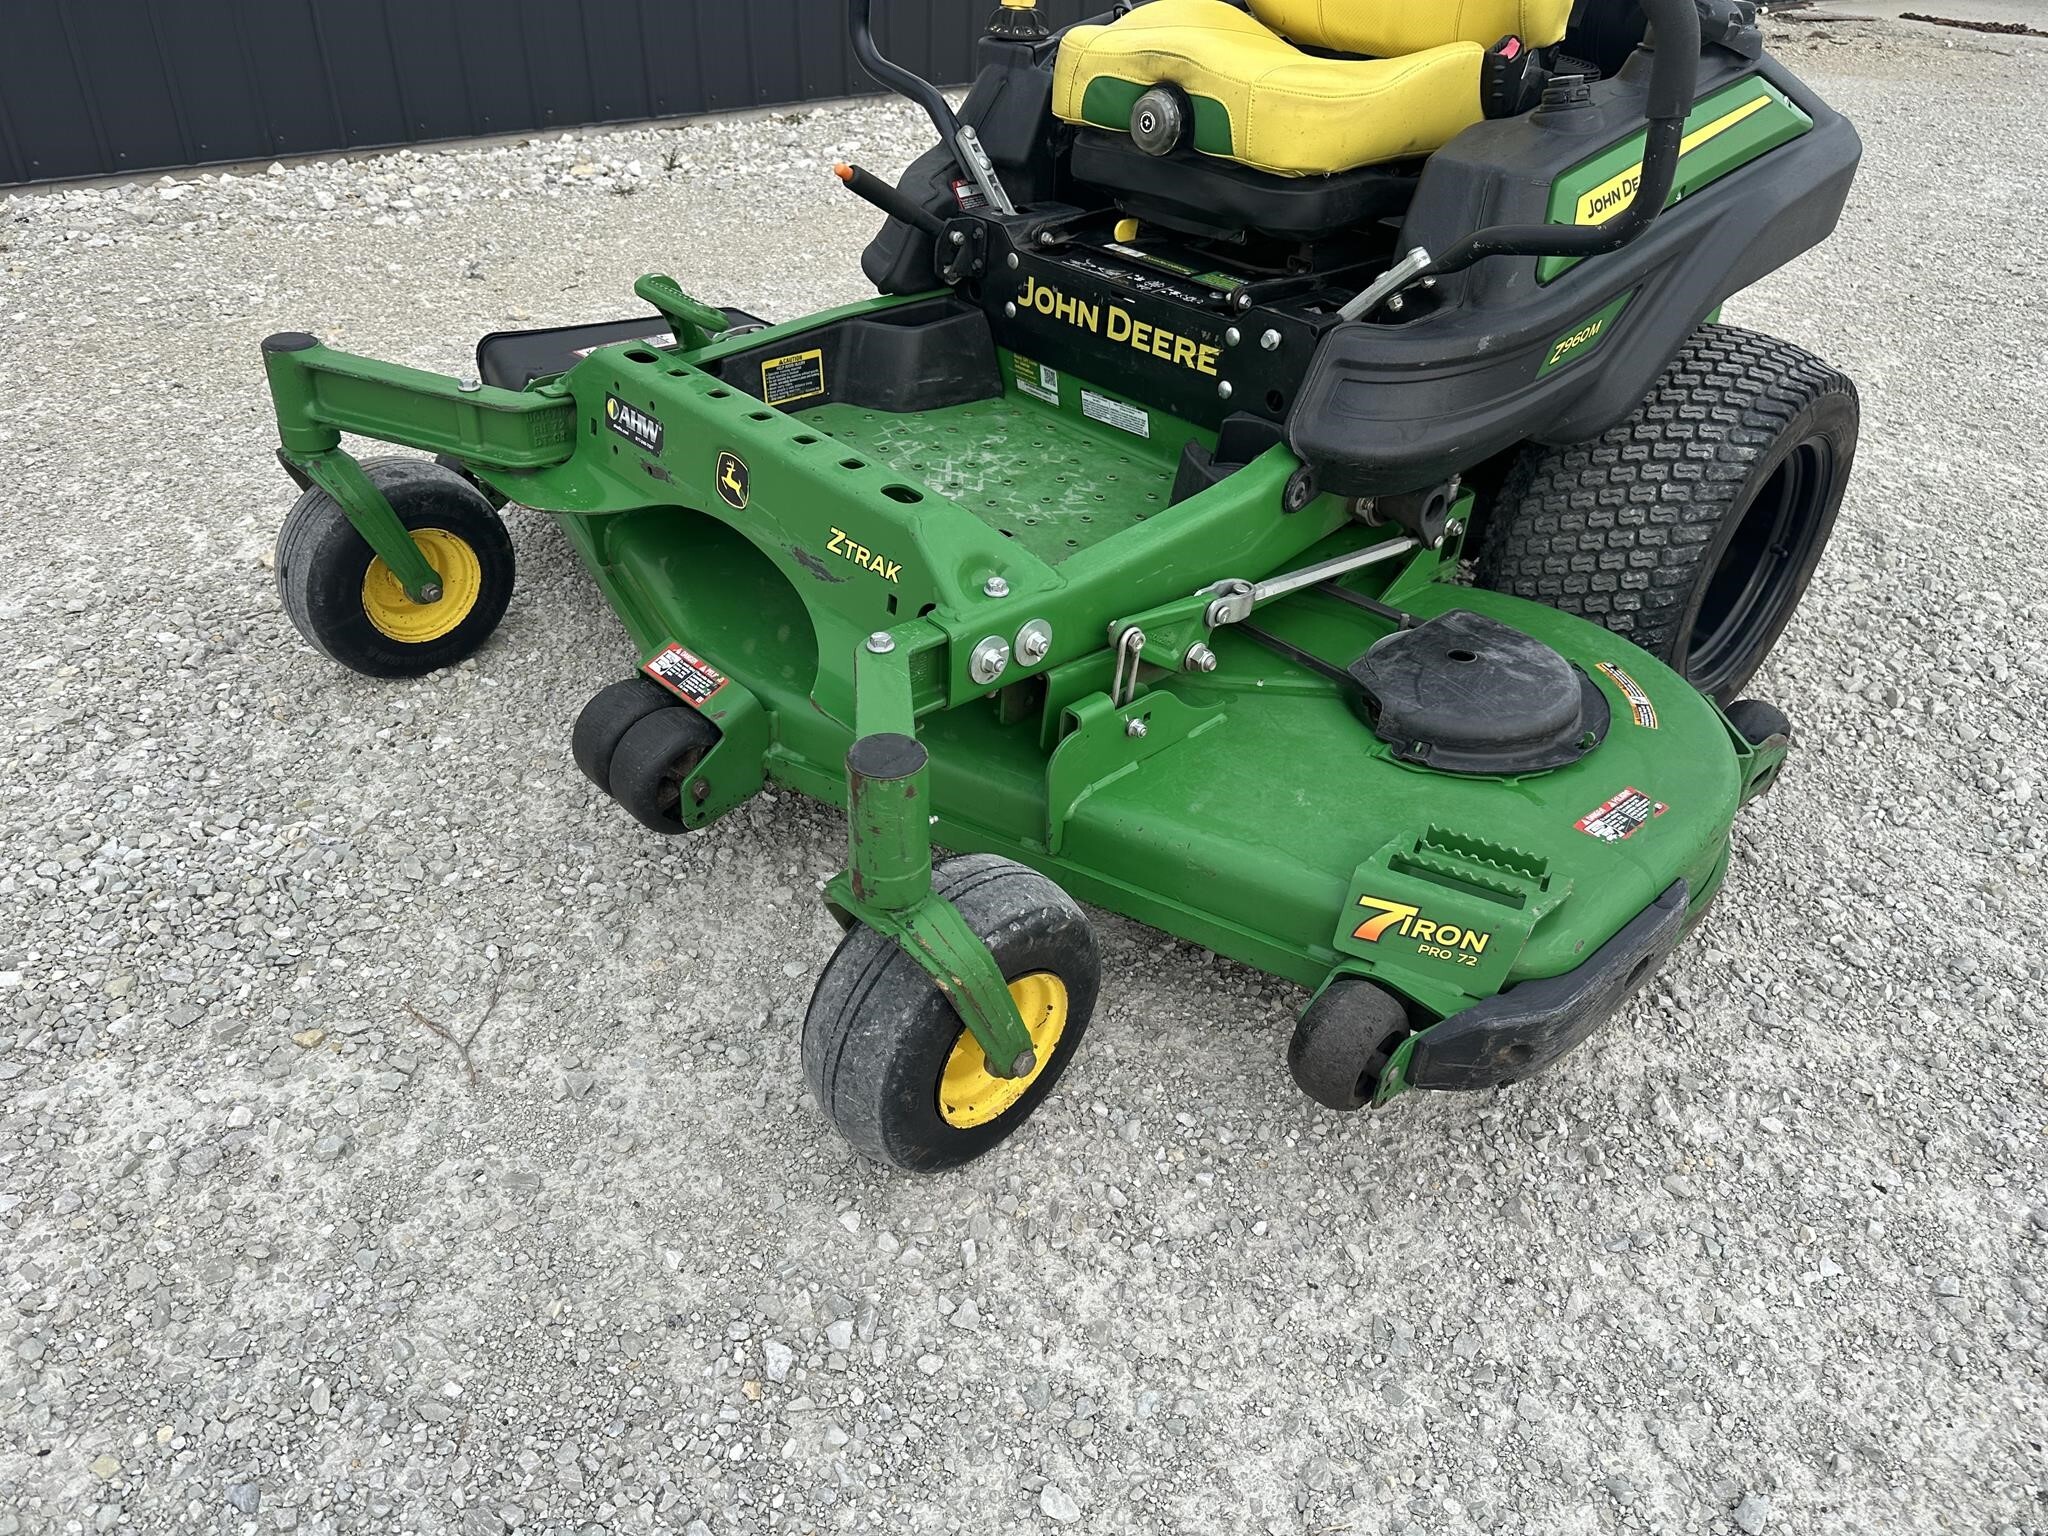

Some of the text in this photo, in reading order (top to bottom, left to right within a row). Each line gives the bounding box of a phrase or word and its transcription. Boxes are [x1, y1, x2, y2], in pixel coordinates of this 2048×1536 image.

[1588, 187, 1621, 219] JOHN
[1017, 275, 1099, 333] JOHN
[1106, 304, 1221, 377] DEERE
[1549, 319, 1603, 365] Z960M
[618, 404, 660, 443] AHW
[826, 526, 903, 584] ZTRAK
[1417, 943, 1479, 967] PRO 72
